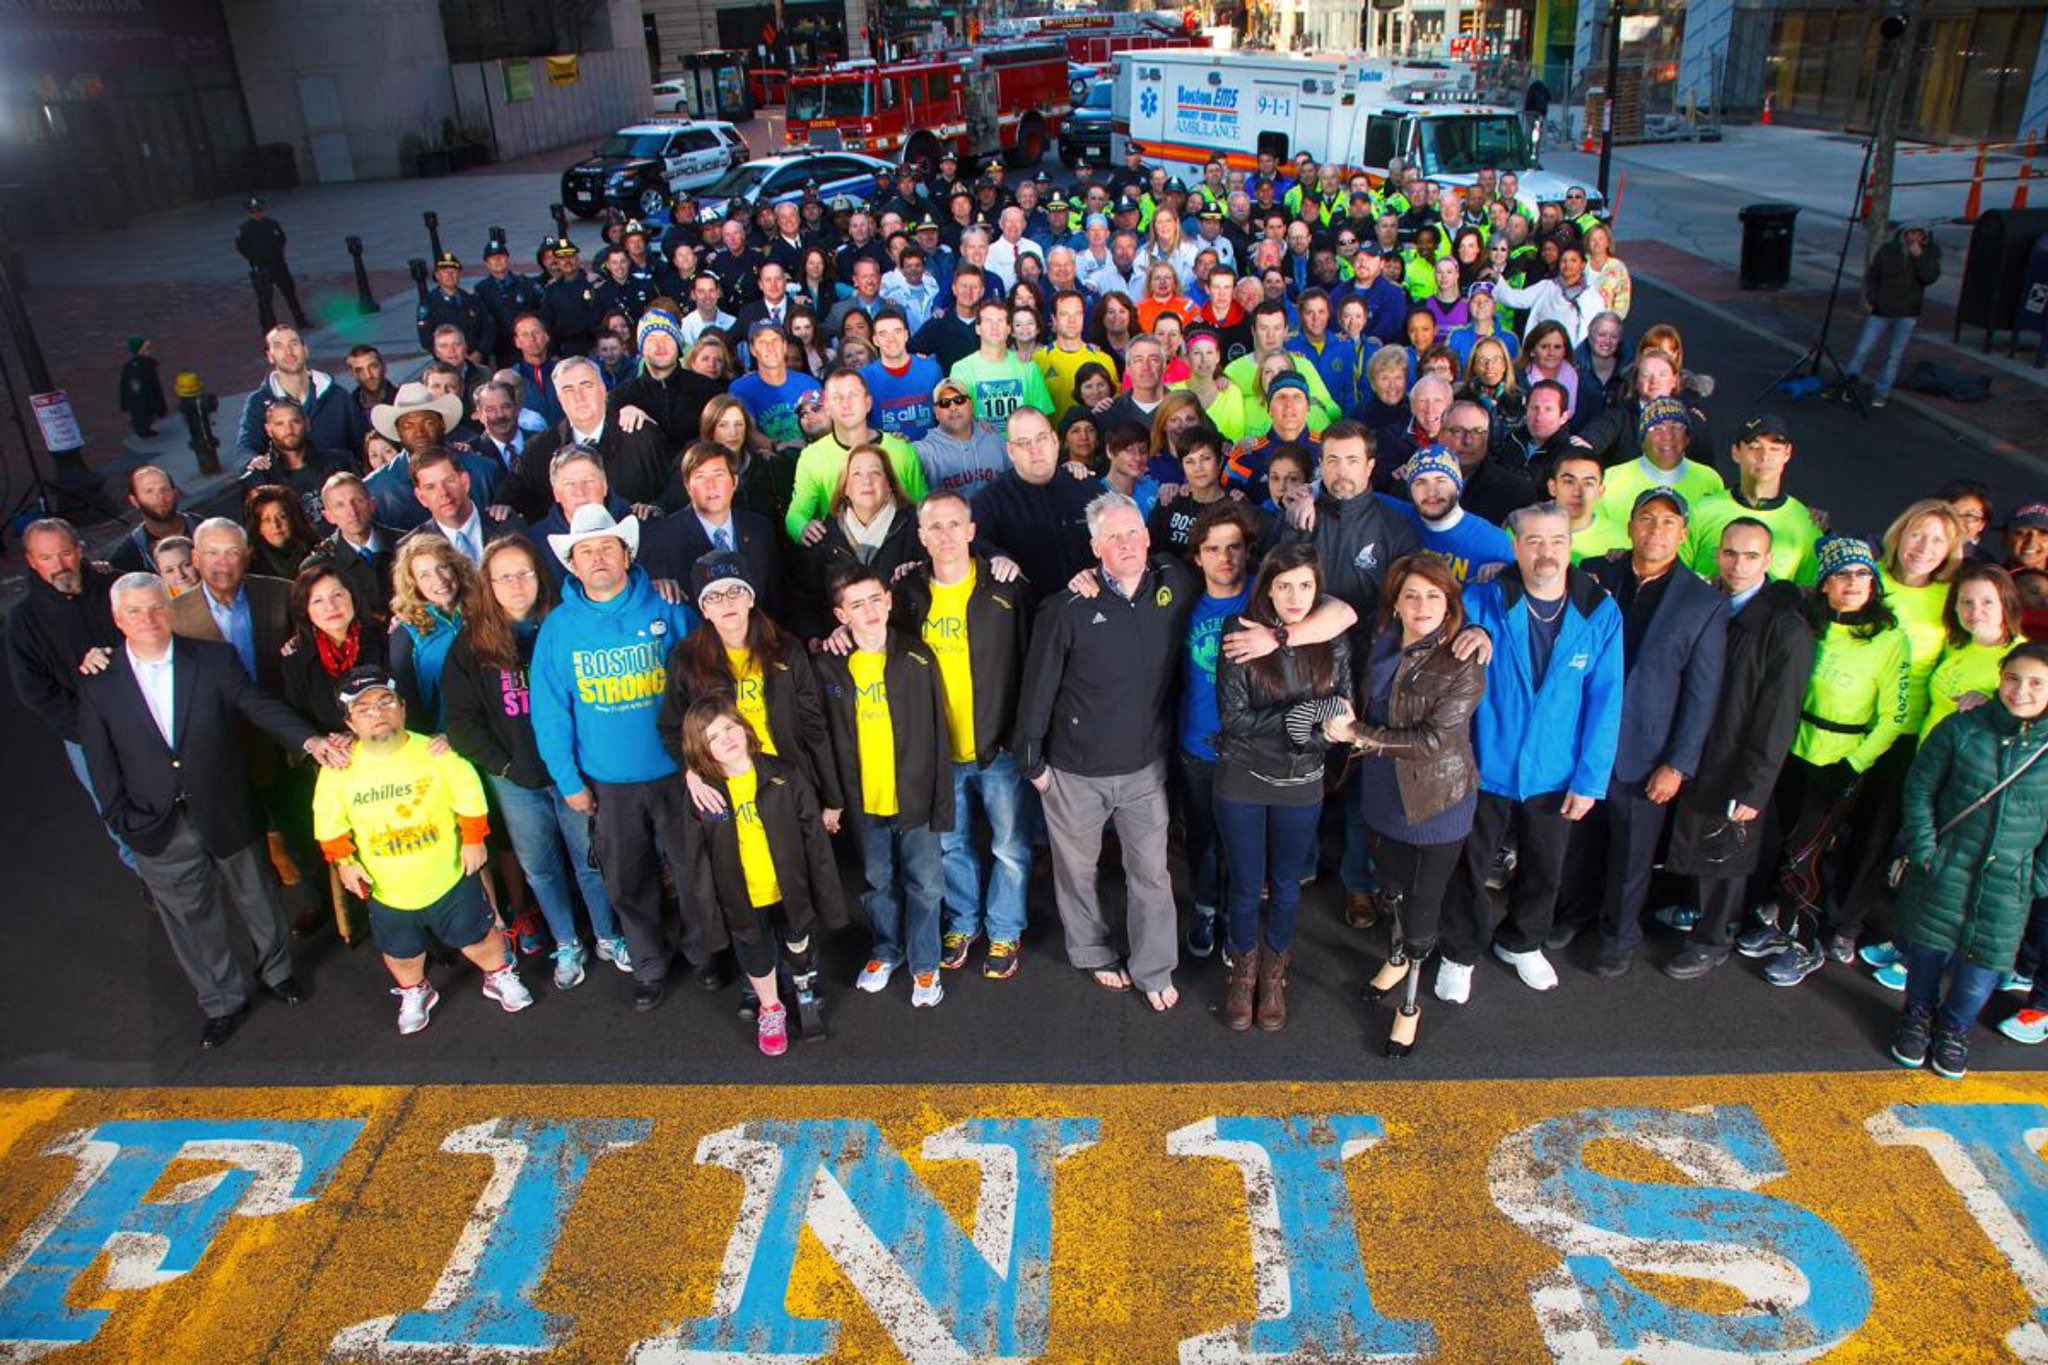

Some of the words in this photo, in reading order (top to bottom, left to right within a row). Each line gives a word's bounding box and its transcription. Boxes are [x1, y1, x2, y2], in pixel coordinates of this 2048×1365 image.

[1178, 85, 1212, 105] Boston
[1213, 87, 1239, 108] EMS
[1258, 95, 1290, 117] 9-1-1
[865, 123, 872, 133] 3
[1177, 119, 1240, 140] AMBULANCE
[881, 409, 896, 424] is
[897, 404, 916, 422] all
[985, 397, 1017, 417] 100
[580, 641, 664, 679] BOSTON
[577, 667, 668, 705] STRONG
[353, 783, 413, 806] Achilles
